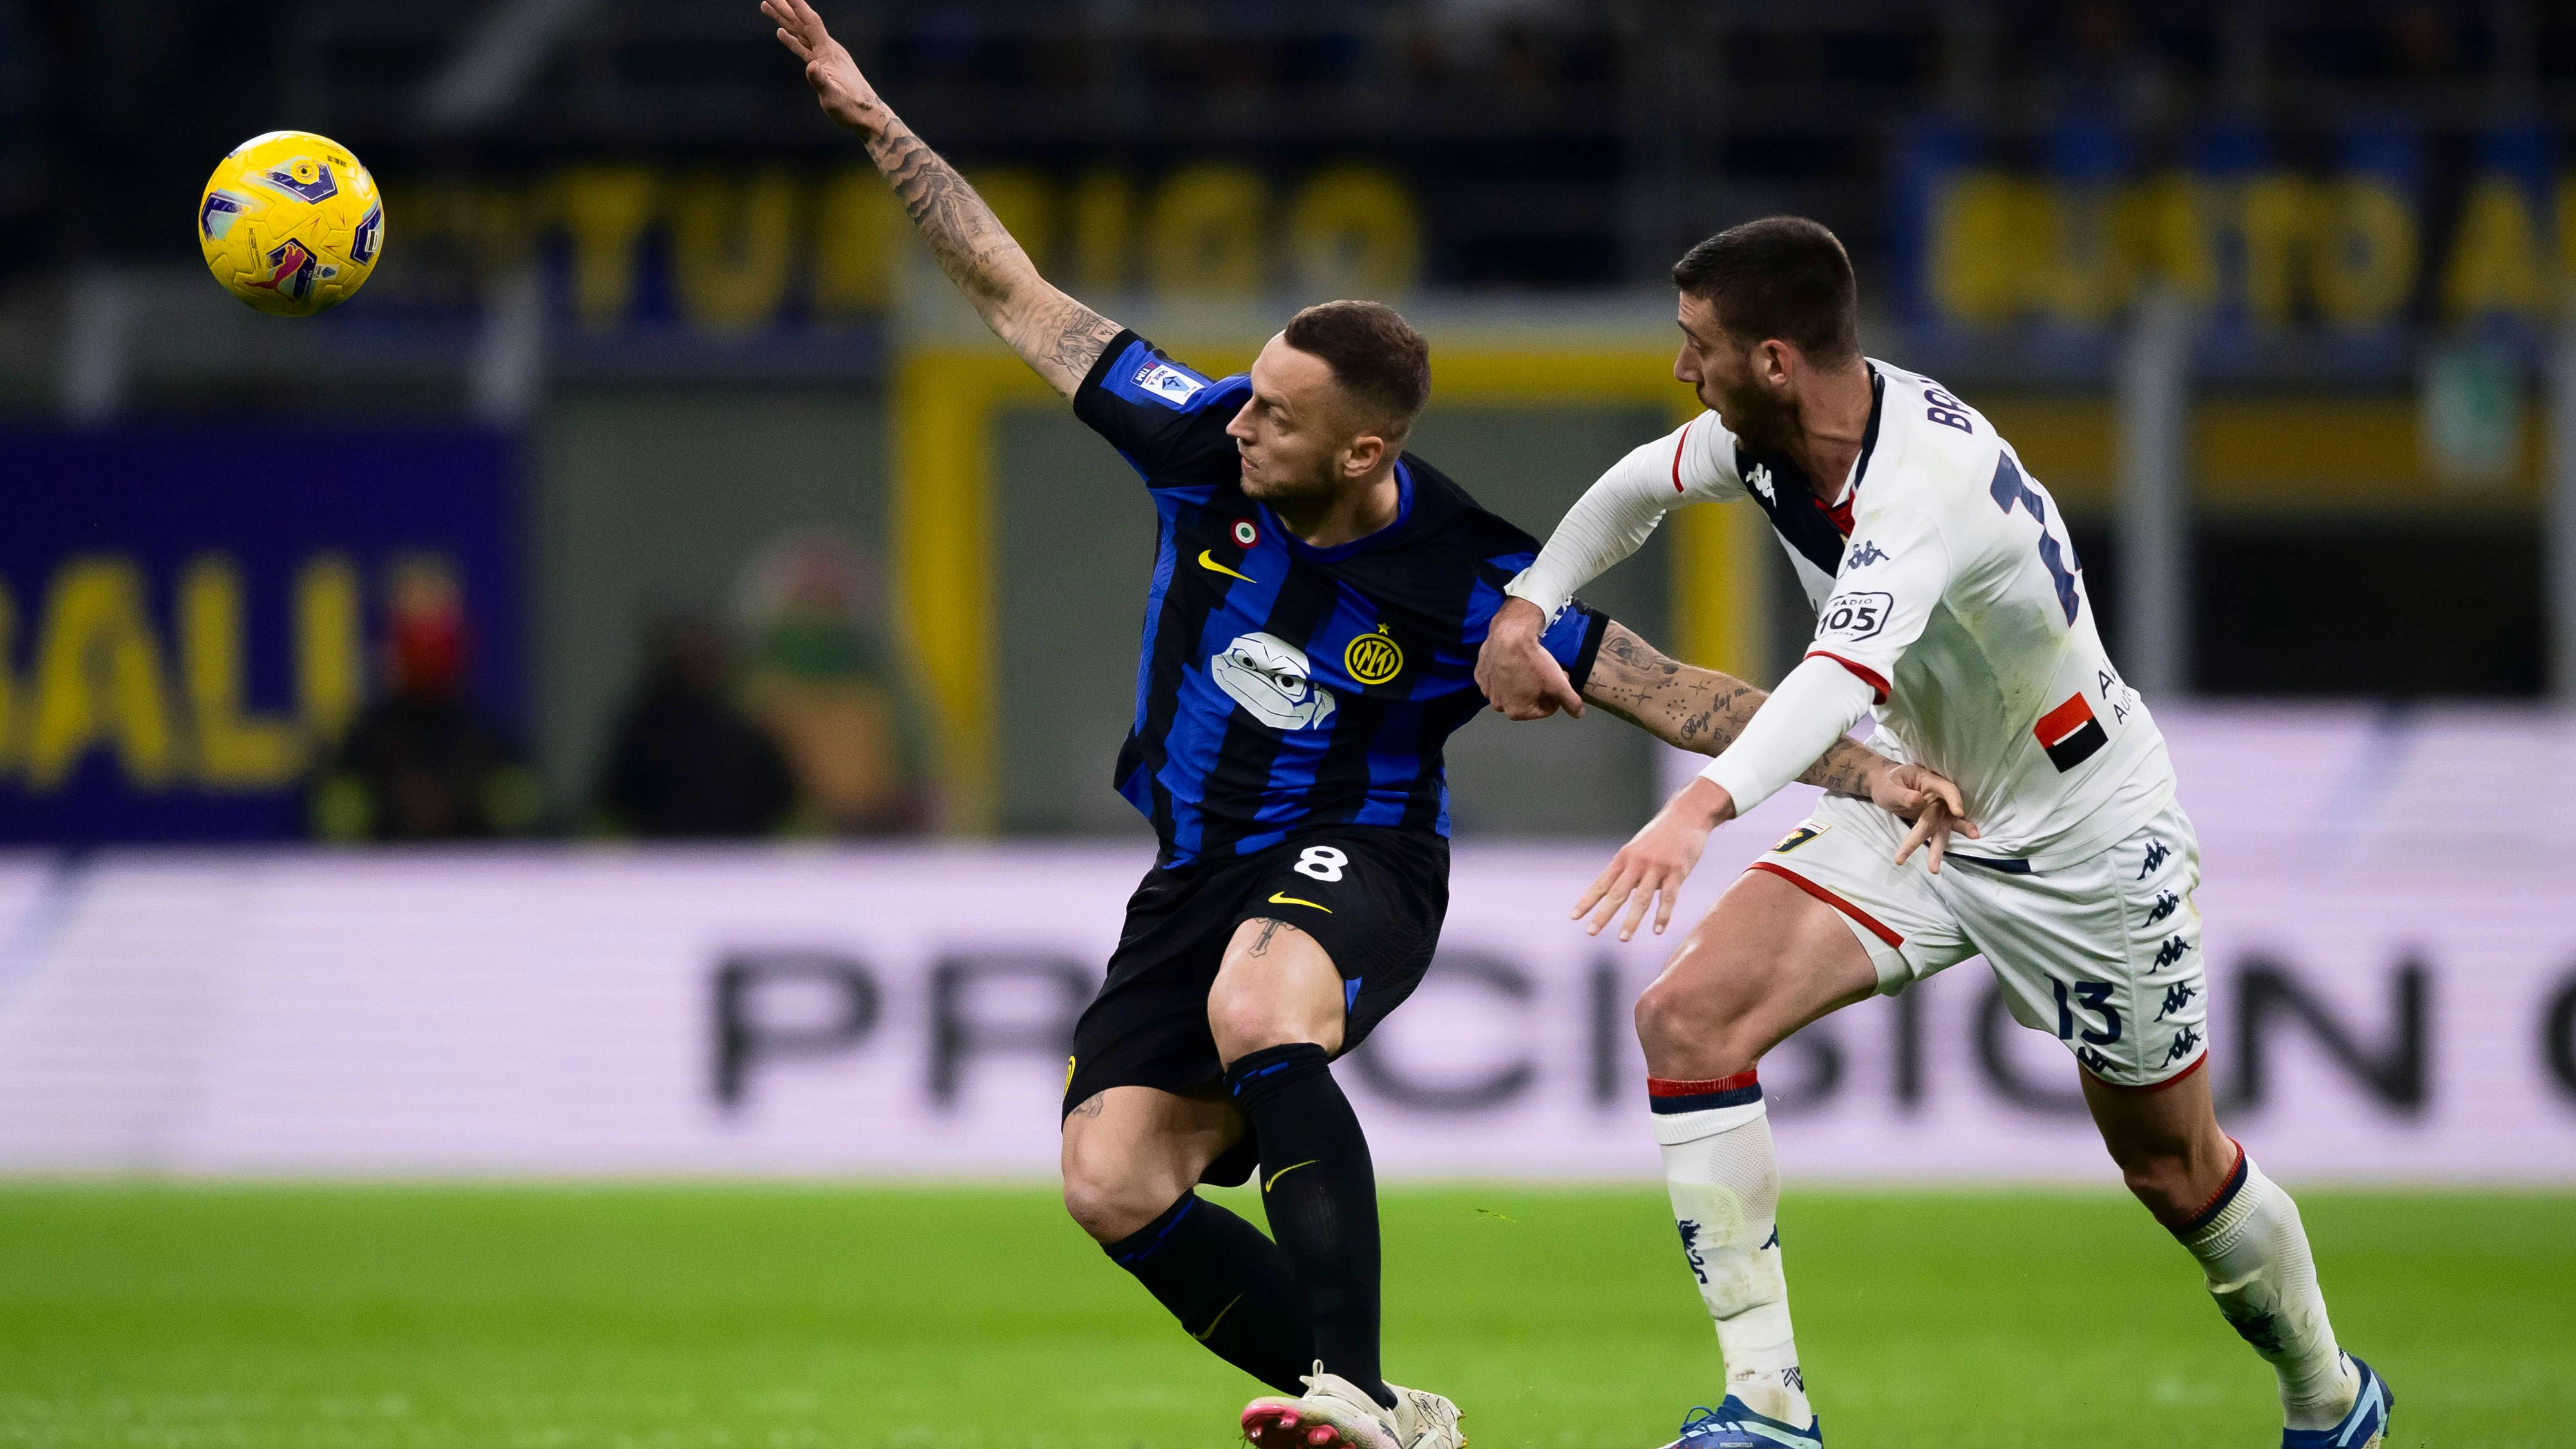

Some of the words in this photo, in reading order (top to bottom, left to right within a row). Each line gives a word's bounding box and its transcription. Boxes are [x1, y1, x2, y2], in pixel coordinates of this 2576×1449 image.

[1135, 367, 1151, 382] TIM
[1153, 370, 1168, 381] SERIE
[1918, 379, 1973, 435] BA
[1819, 607, 1879, 635] 105
[1294, 846, 1349, 882] 8
[2043, 972, 2122, 1045] 13
[708, 942, 2438, 1117] PRCIION
